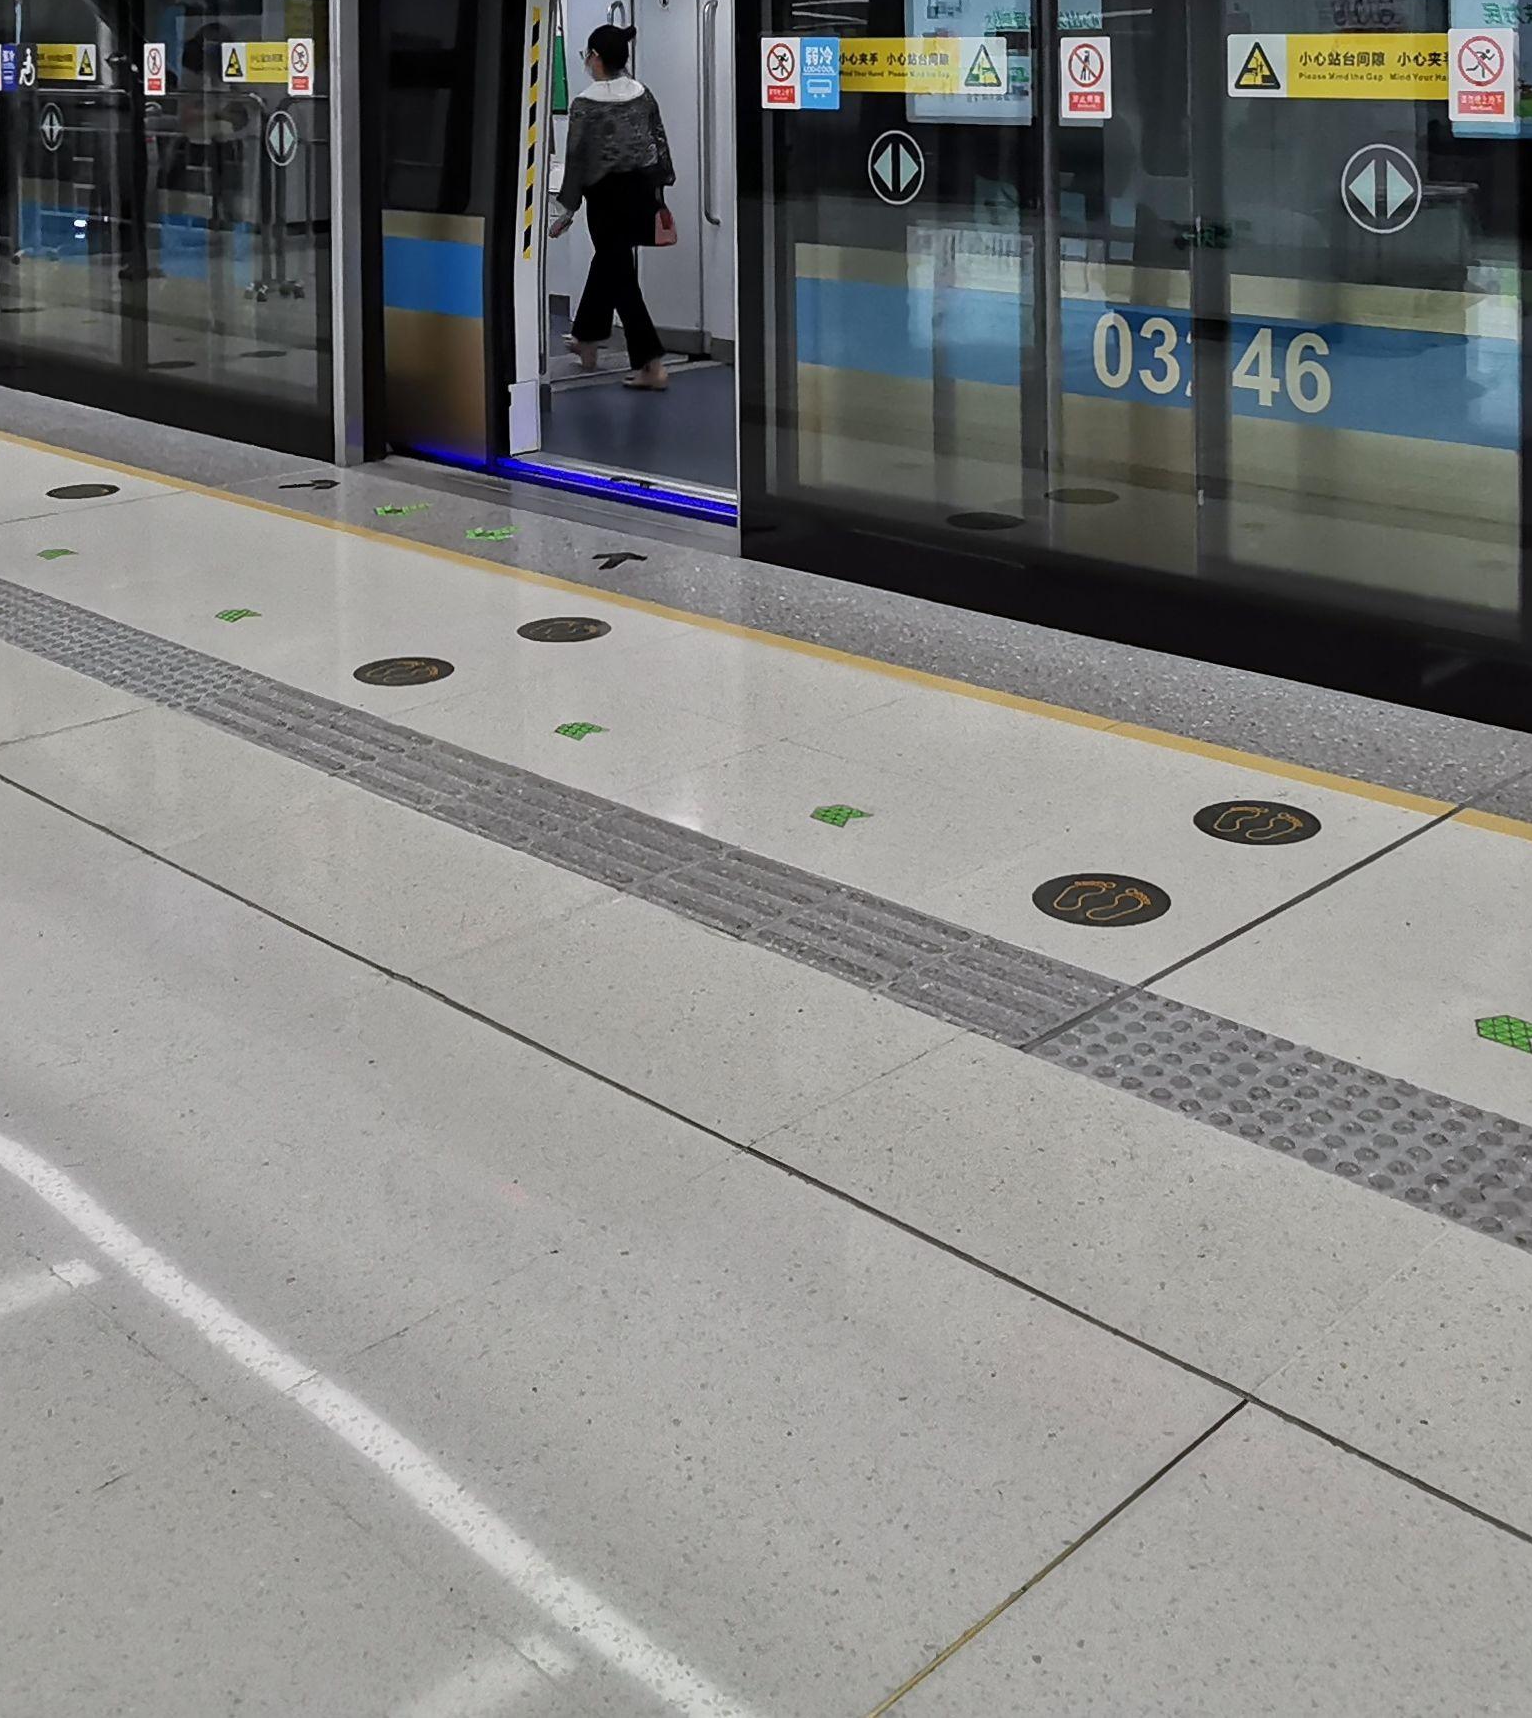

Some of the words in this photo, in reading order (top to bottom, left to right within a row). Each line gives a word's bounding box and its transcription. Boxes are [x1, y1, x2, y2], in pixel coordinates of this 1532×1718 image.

[1299, 51, 1386, 67] 小心站台间隙
[1093, 313, 1332, 413] 0346
